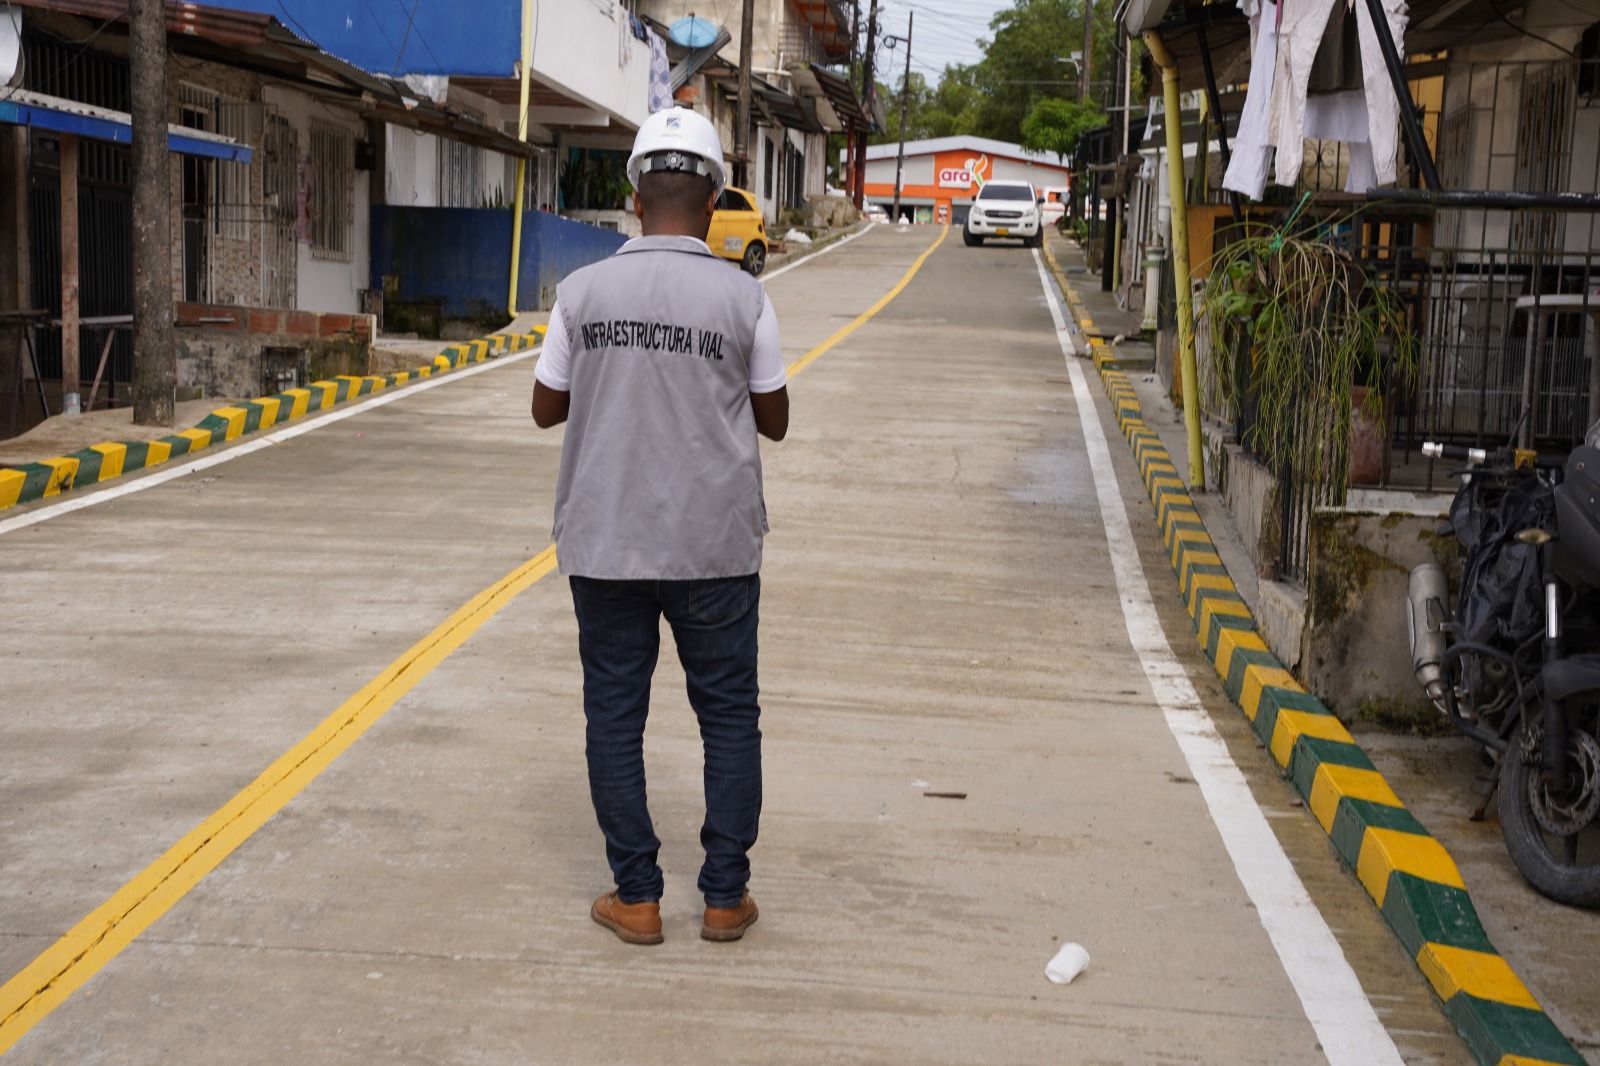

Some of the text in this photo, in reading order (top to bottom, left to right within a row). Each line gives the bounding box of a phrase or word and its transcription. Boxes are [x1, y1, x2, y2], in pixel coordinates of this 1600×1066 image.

[941, 170, 970, 182] ara
[581, 320, 724, 360] INFRAESTRUCTURA VIAL
